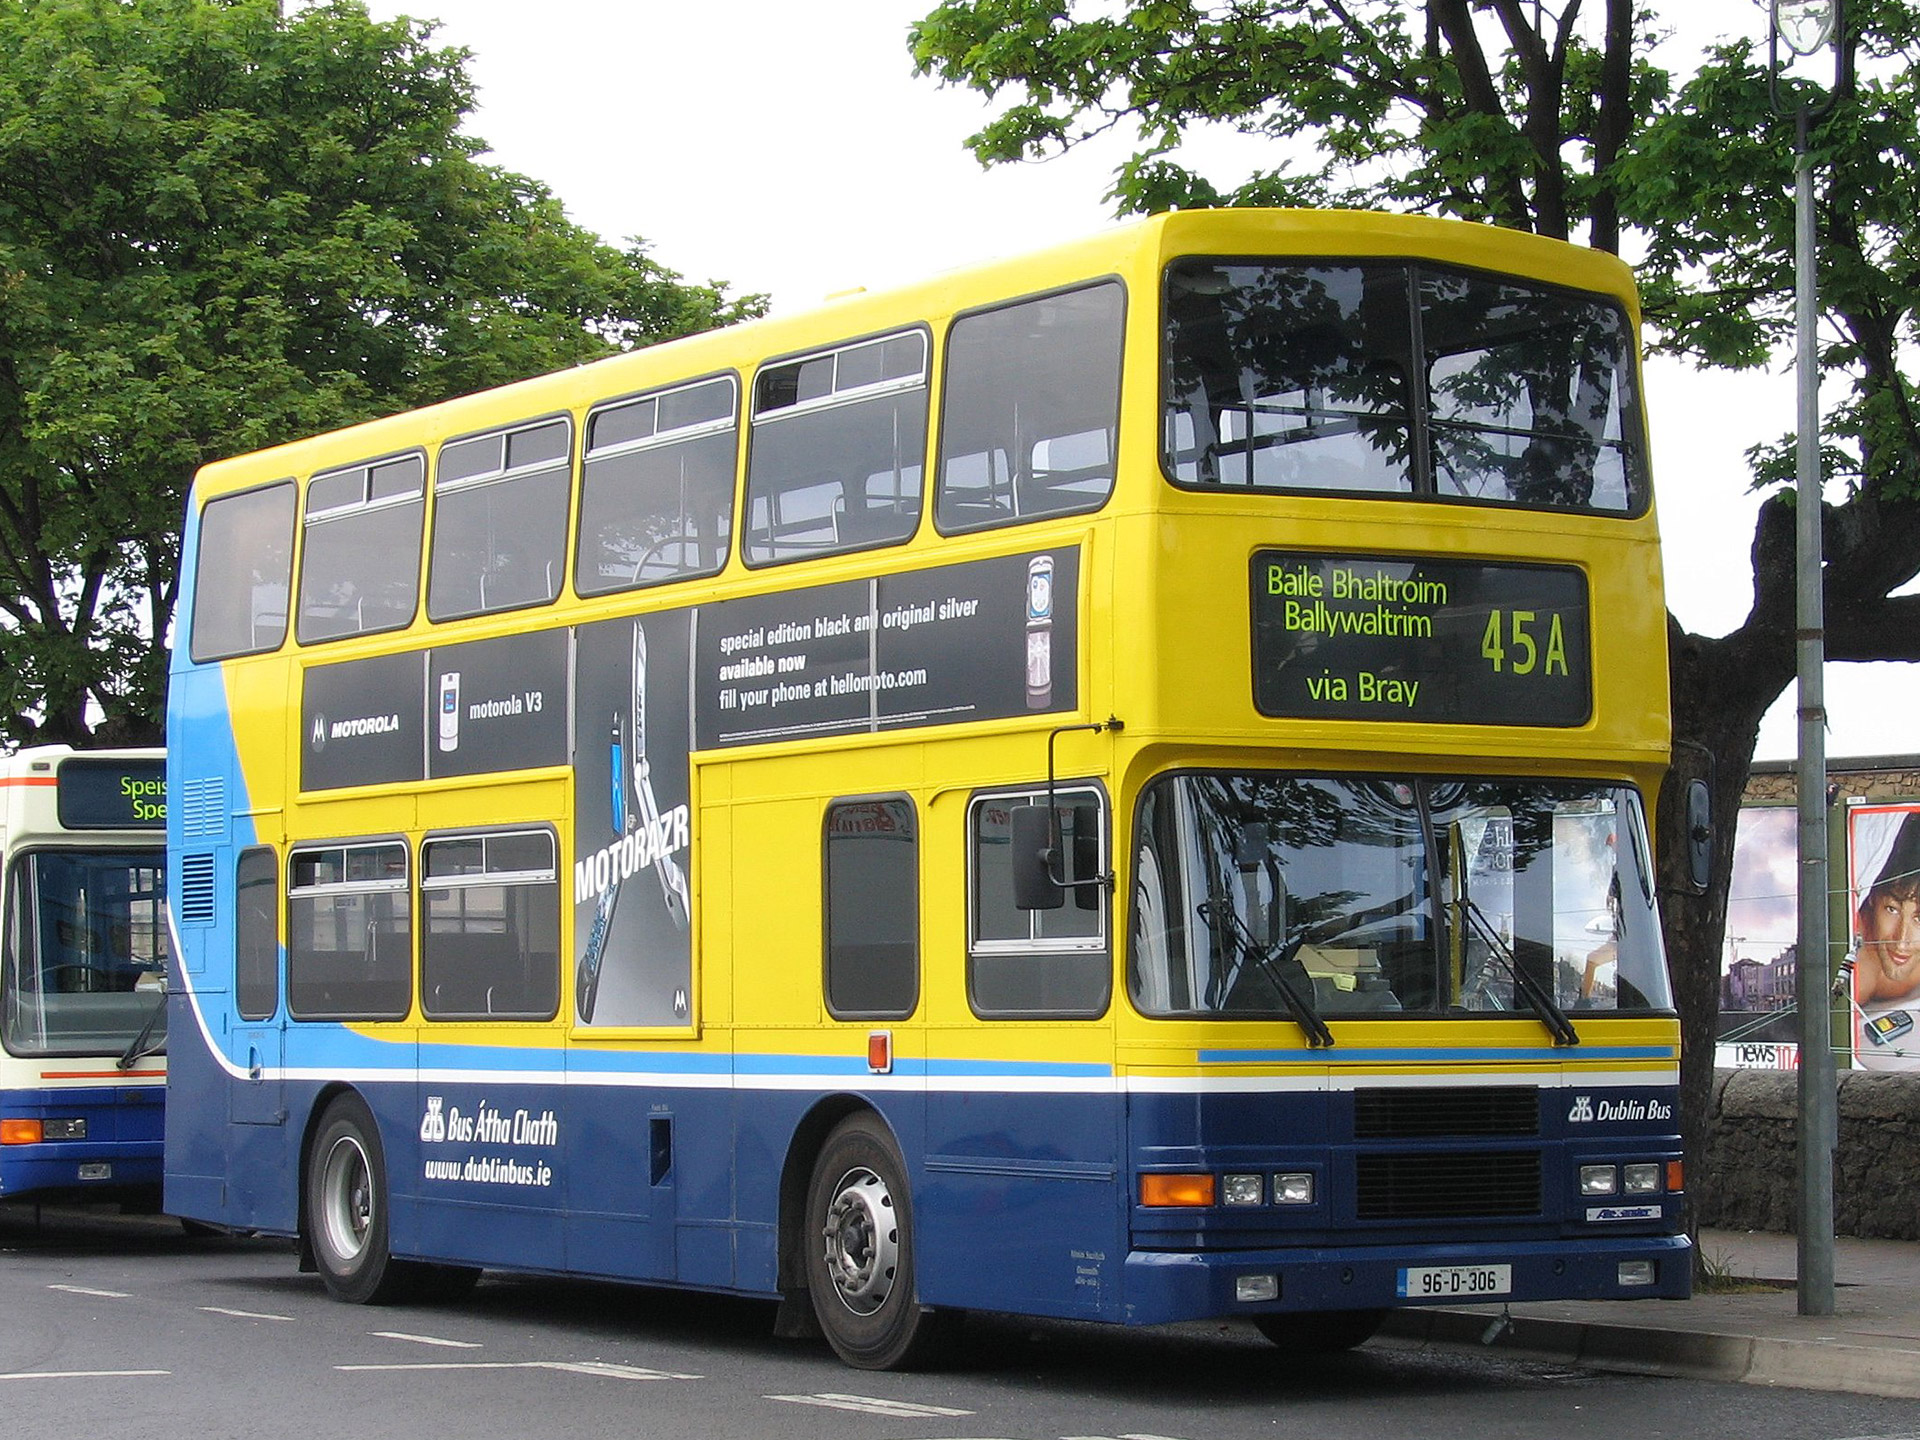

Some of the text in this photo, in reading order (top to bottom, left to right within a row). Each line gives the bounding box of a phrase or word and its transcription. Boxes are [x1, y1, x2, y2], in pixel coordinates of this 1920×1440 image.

[1267, 565, 1447, 605] Baile Bhaltroim
[720, 627, 764, 656] special
[767, 622, 811, 646] edition
[815, 613, 851, 639] black
[882, 600, 936, 631] original
[938, 597, 979, 620] silver
[1285, 600, 1432, 638] Ballywaltrim
[1481, 609, 1569, 677] 45A
[719, 654, 807, 682] available now
[469, 691, 543, 720] motorola V3
[719, 668, 928, 712] fill your phone at hellomoto.com
[1306, 668, 1419, 708] via Bray
[331, 714, 400, 739] MOTOROLA
[120, 775, 168, 800] Speis
[575, 803, 689, 905] MOTORAZR
[1735, 1043, 1776, 1063] news
[447, 1106, 473, 1142] Bus
[473, 1099, 512, 1144] Átha
[1596, 1099, 1672, 1121] Dublin Bus
[425, 1155, 552, 1187] www.dublinbus.ie
[1422, 1271, 1496, 1293] 96-D-306
